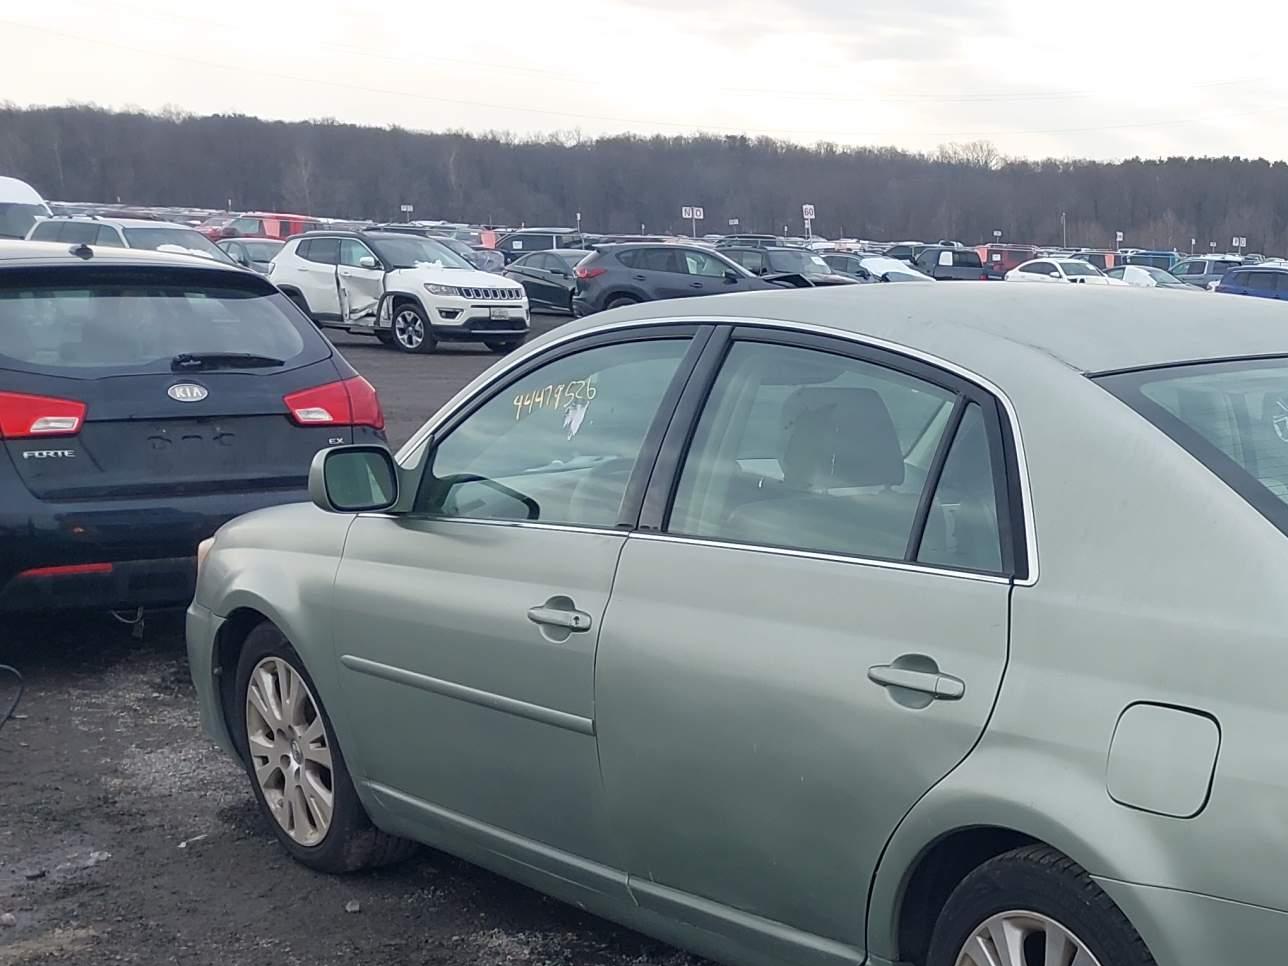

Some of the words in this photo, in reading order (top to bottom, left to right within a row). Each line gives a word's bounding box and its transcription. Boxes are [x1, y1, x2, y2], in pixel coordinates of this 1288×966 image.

[804, 207, 814, 216] 60
[174, 386, 203, 398] KIA
[513, 376, 597, 421] 44479526
[328, 437, 345, 445] EX
[22, 449, 77, 460] FORTE
